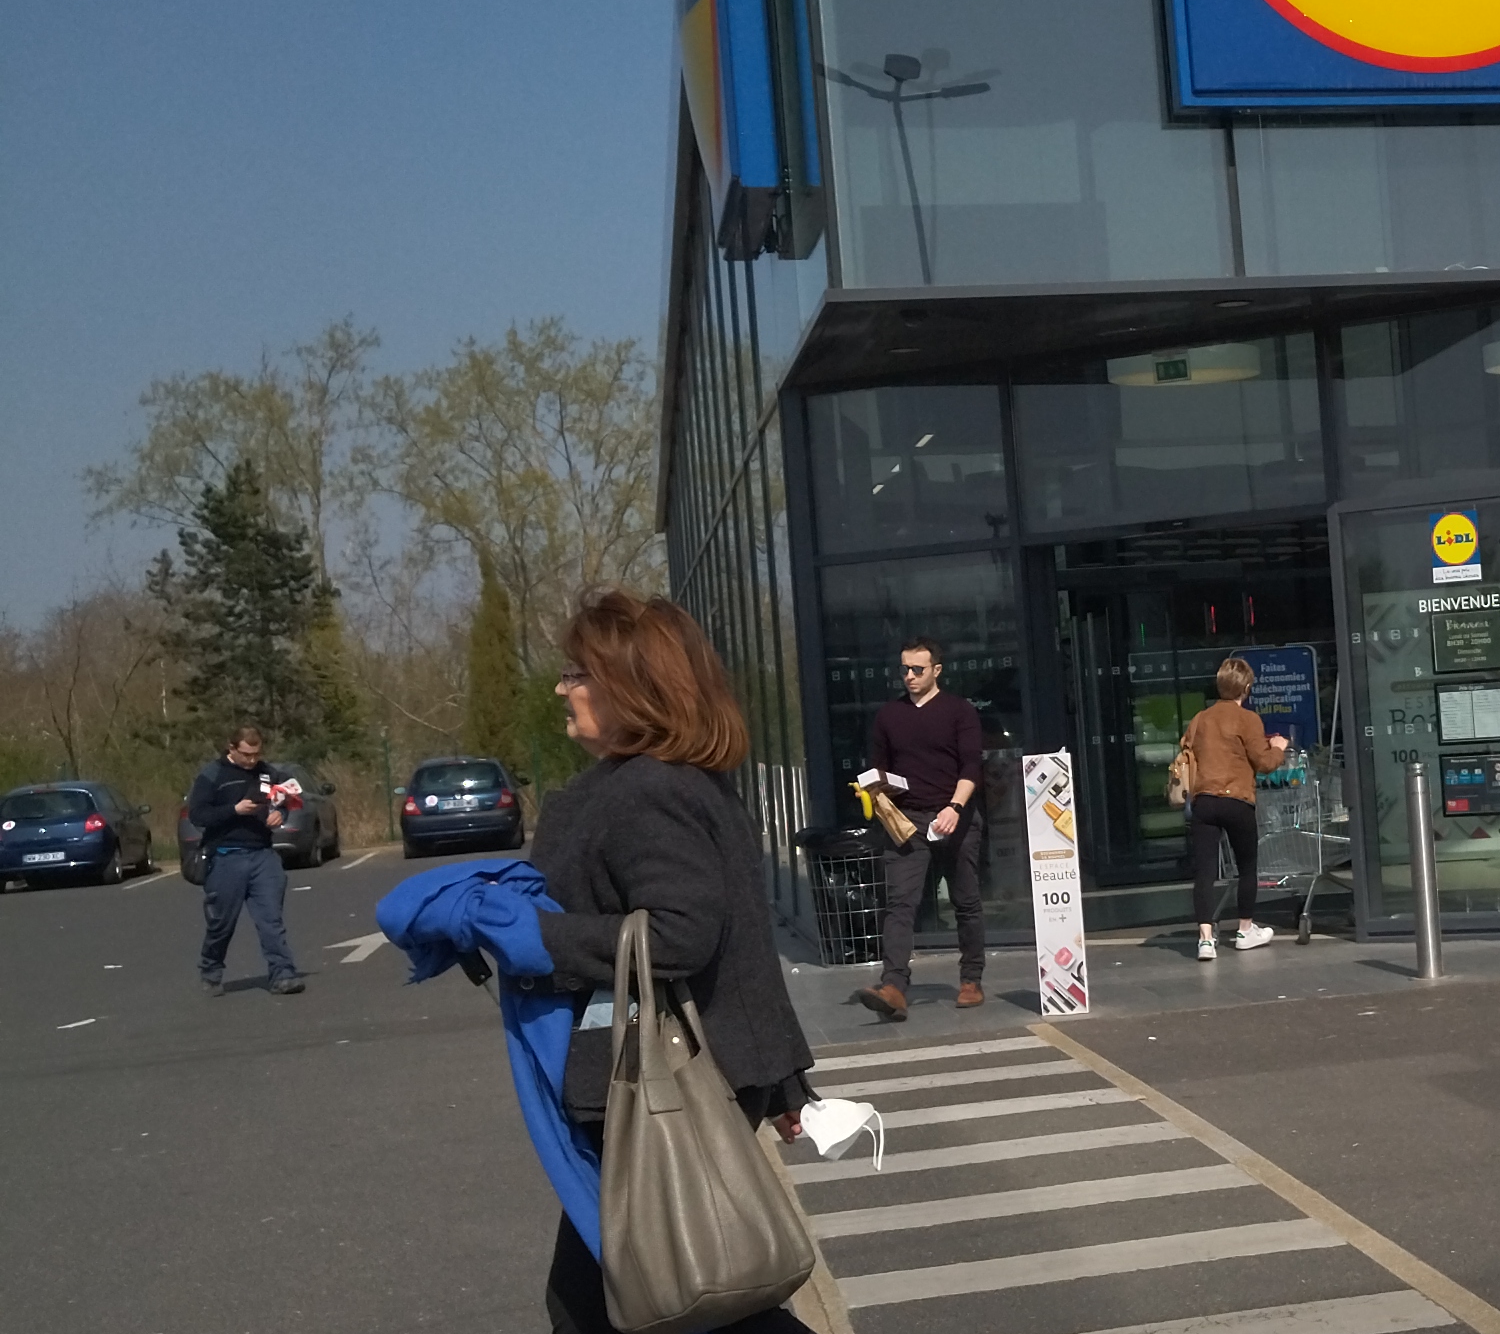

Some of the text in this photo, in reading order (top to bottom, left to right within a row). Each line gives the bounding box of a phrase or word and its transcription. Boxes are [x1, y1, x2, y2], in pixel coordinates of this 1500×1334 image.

[1418, 593, 1500, 614] BIENVENUE
[1260, 663, 1286, 672] Faites
[1259, 672, 1307, 683] économies
[1273, 704, 1293, 714] Plus
[1391, 749, 1419, 763] 100
[1033, 868, 1077, 882] Beauté
[1042, 891, 1071, 906] 100
